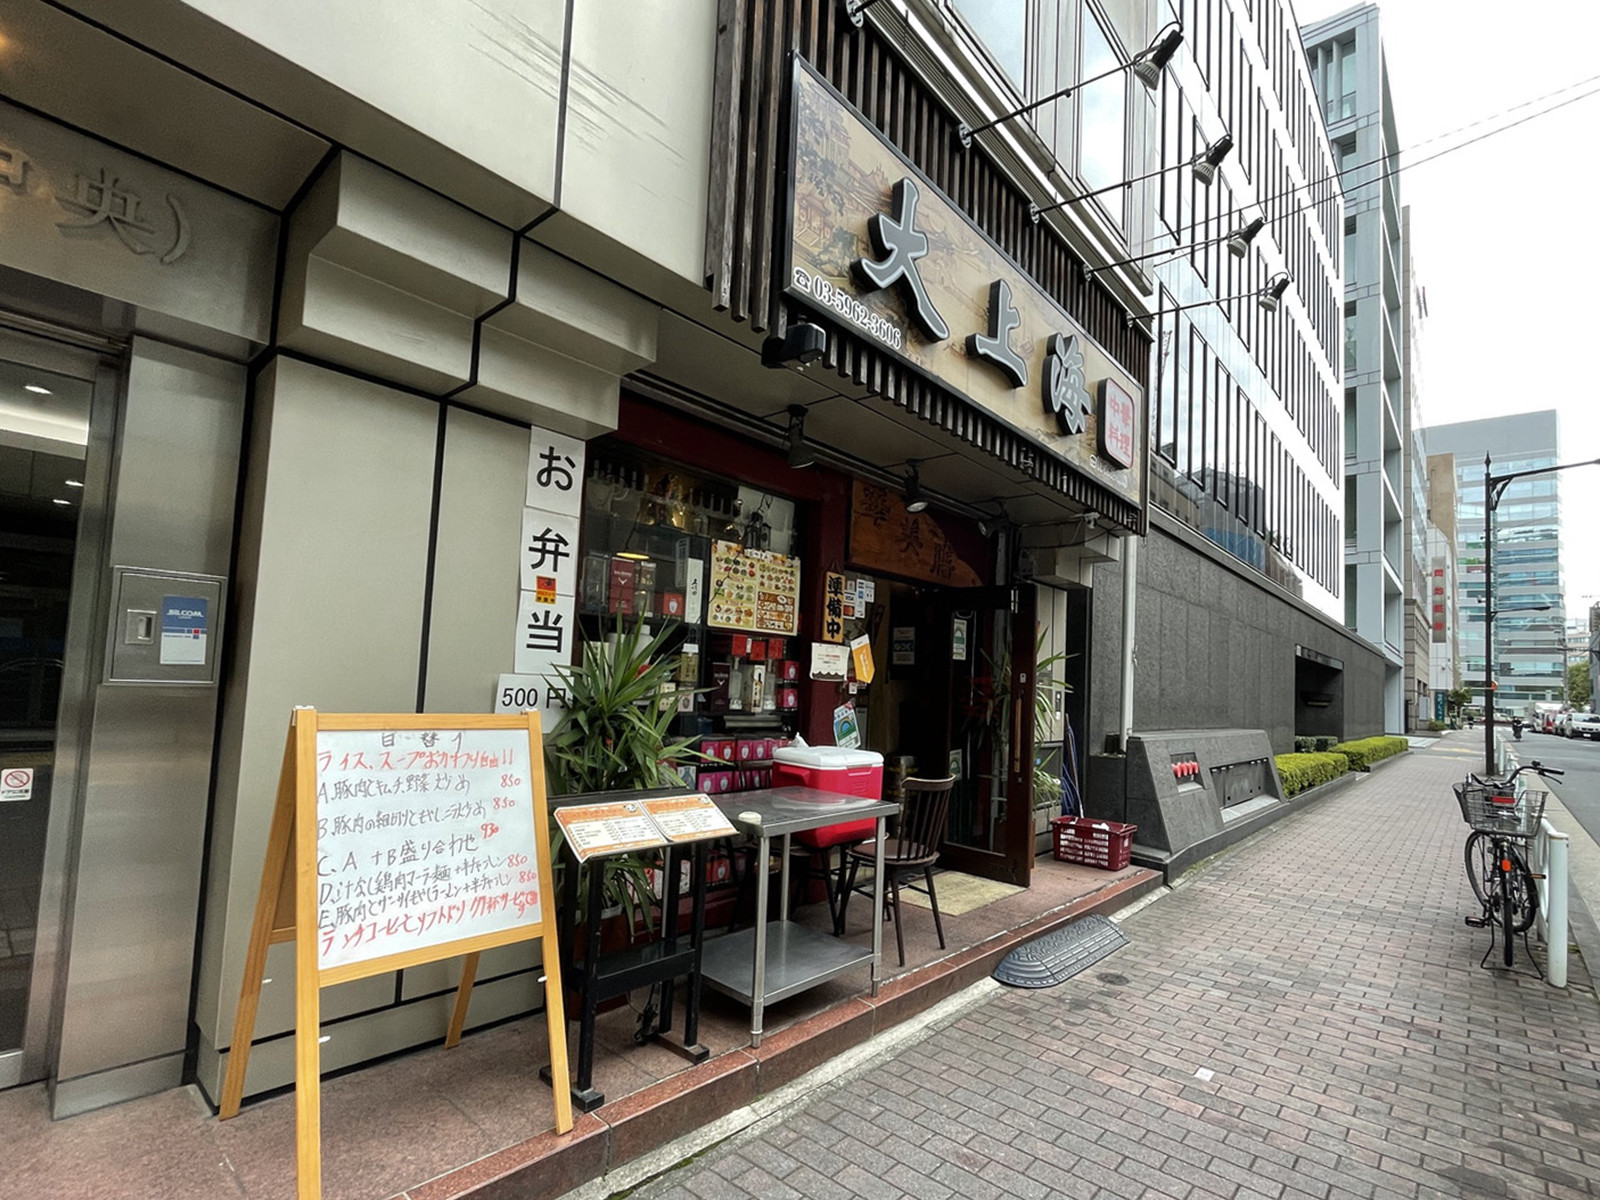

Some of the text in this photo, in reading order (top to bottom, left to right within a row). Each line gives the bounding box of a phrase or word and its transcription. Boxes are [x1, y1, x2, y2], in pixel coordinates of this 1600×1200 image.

[814, 276, 903, 350] 03-5962-3606
[851, 176, 1092, 436] 大上海
[526, 446, 575, 653] お弁当
[826, 575, 844, 640] 準備中
[502, 688, 567, 709] 500 円
[493, 796, 516, 810] 850
[507, 853, 528, 869] 850
